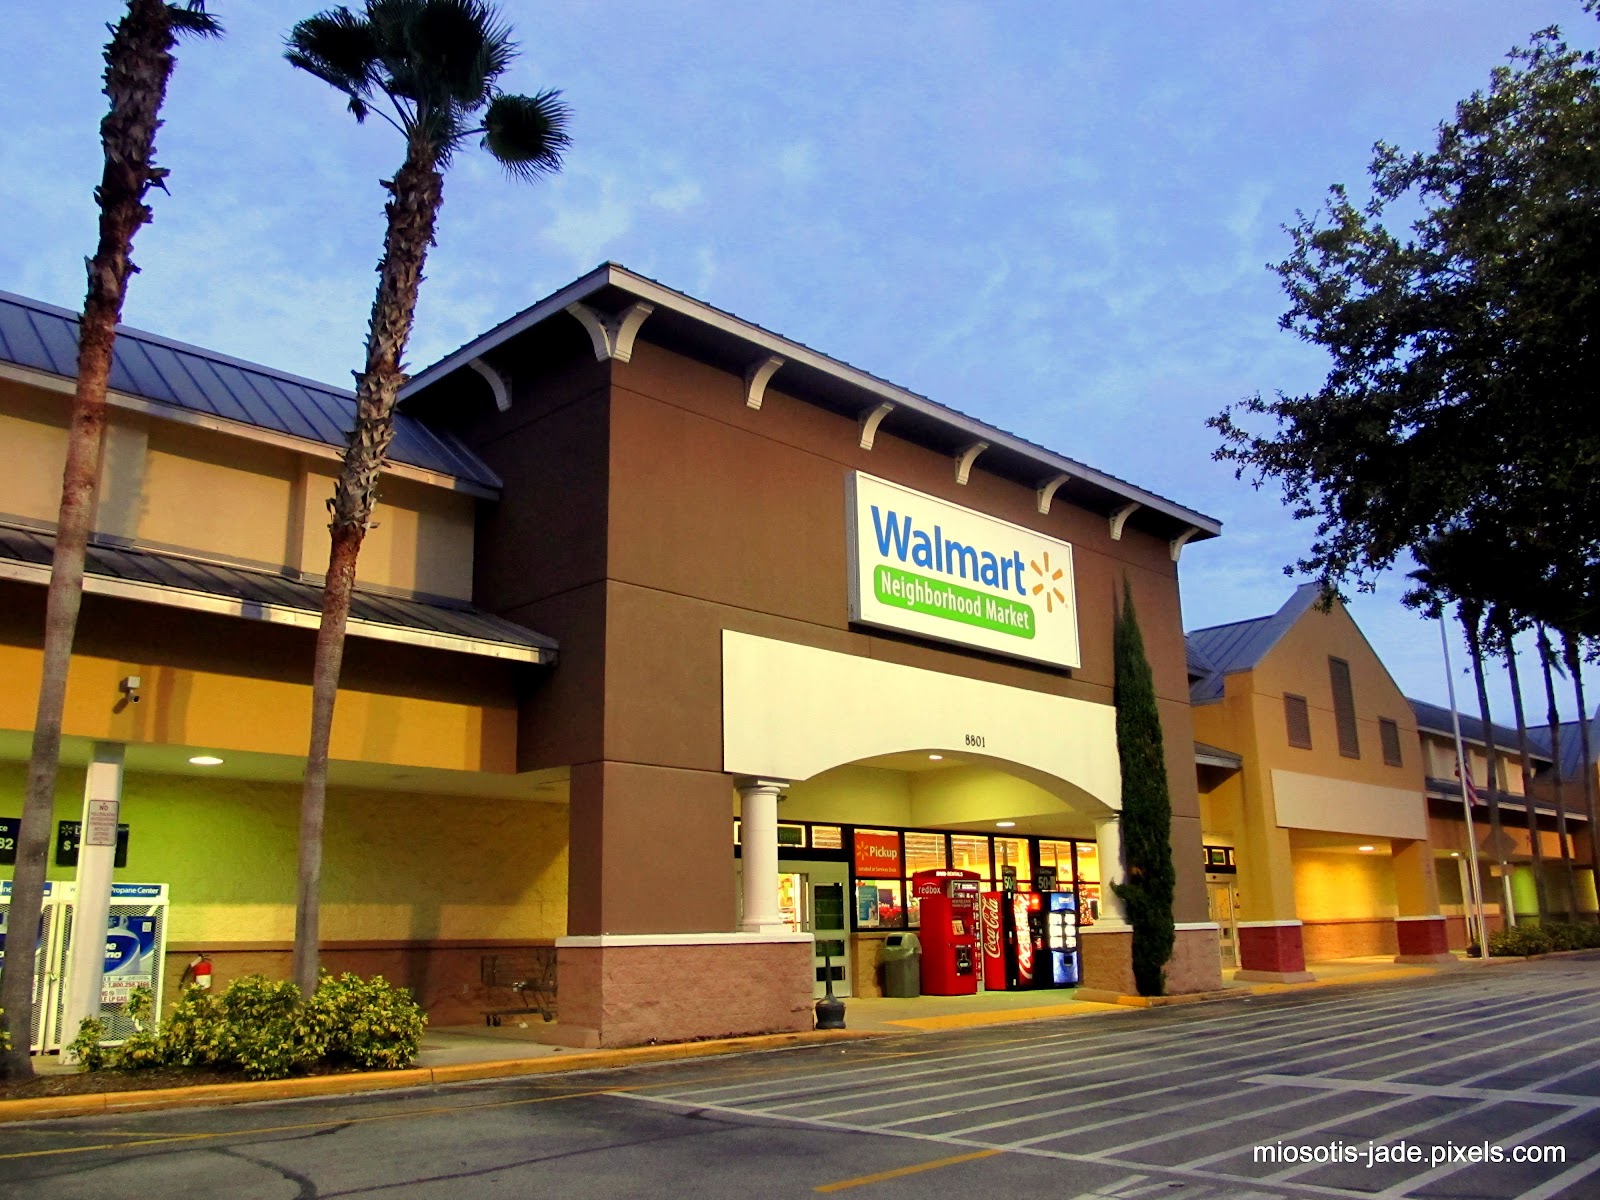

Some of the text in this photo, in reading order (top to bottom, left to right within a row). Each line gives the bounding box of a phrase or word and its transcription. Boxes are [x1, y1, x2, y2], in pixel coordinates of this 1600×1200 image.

[871, 505, 1027, 596] Walmart
[881, 570, 1029, 630] Neighborhood Market
[965, 734, 985, 748] 8801
[869, 846, 898, 860] Pickup
[918, 885, 941, 894] redbox
